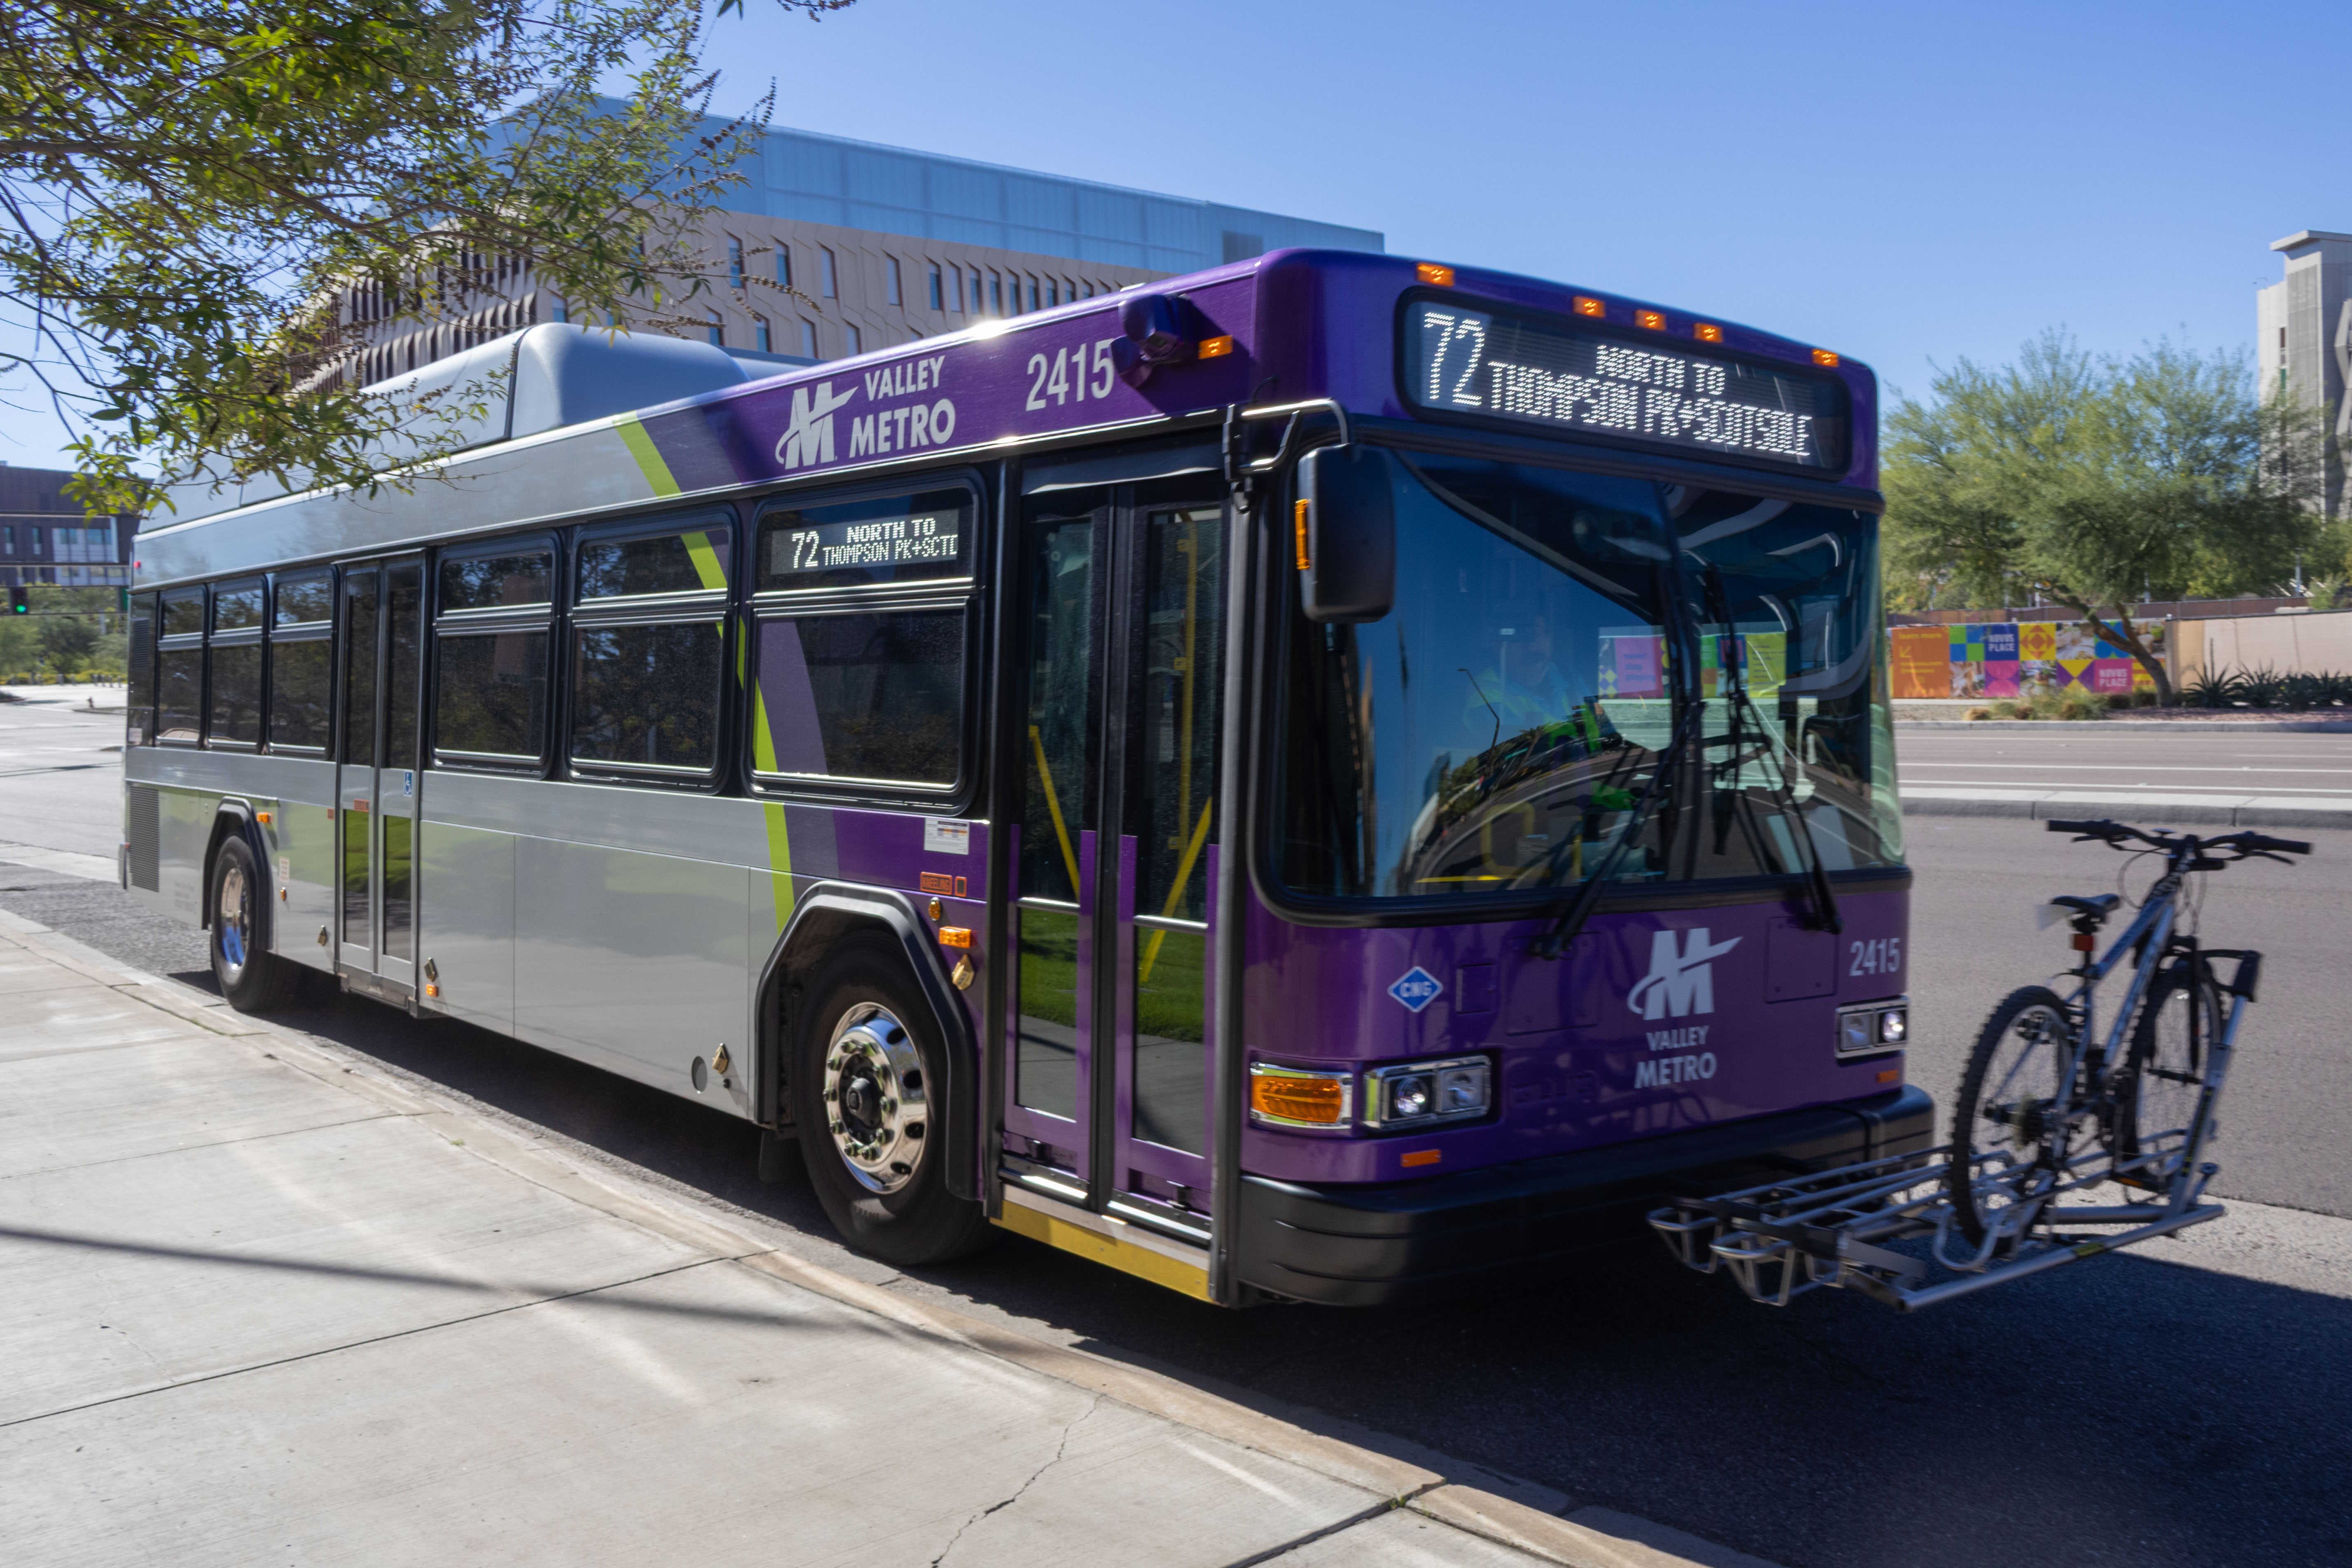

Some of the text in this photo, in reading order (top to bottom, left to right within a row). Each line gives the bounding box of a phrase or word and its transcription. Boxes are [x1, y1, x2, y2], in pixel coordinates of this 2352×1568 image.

[865, 355, 945, 401] VALLEY
[1026, 338, 1115, 411] 2415
[1424, 312, 1485, 406] 72
[1596, 345, 1725, 395] NORTH TO
[1488, 361, 1639, 430] THOMPSON
[849, 399, 956, 458] METRO
[847, 517, 935, 543] NORTH TO
[792, 531, 819, 568] 72
[823, 541, 889, 566] THOMPSON
[1988, 643, 2015, 652] PLACE
[2099, 678, 2127, 687] PLACE
[1849, 937, 1901, 976] 2415
[1646, 1025, 1709, 1052] VALLEY
[1634, 1052, 1717, 1089] METRO
